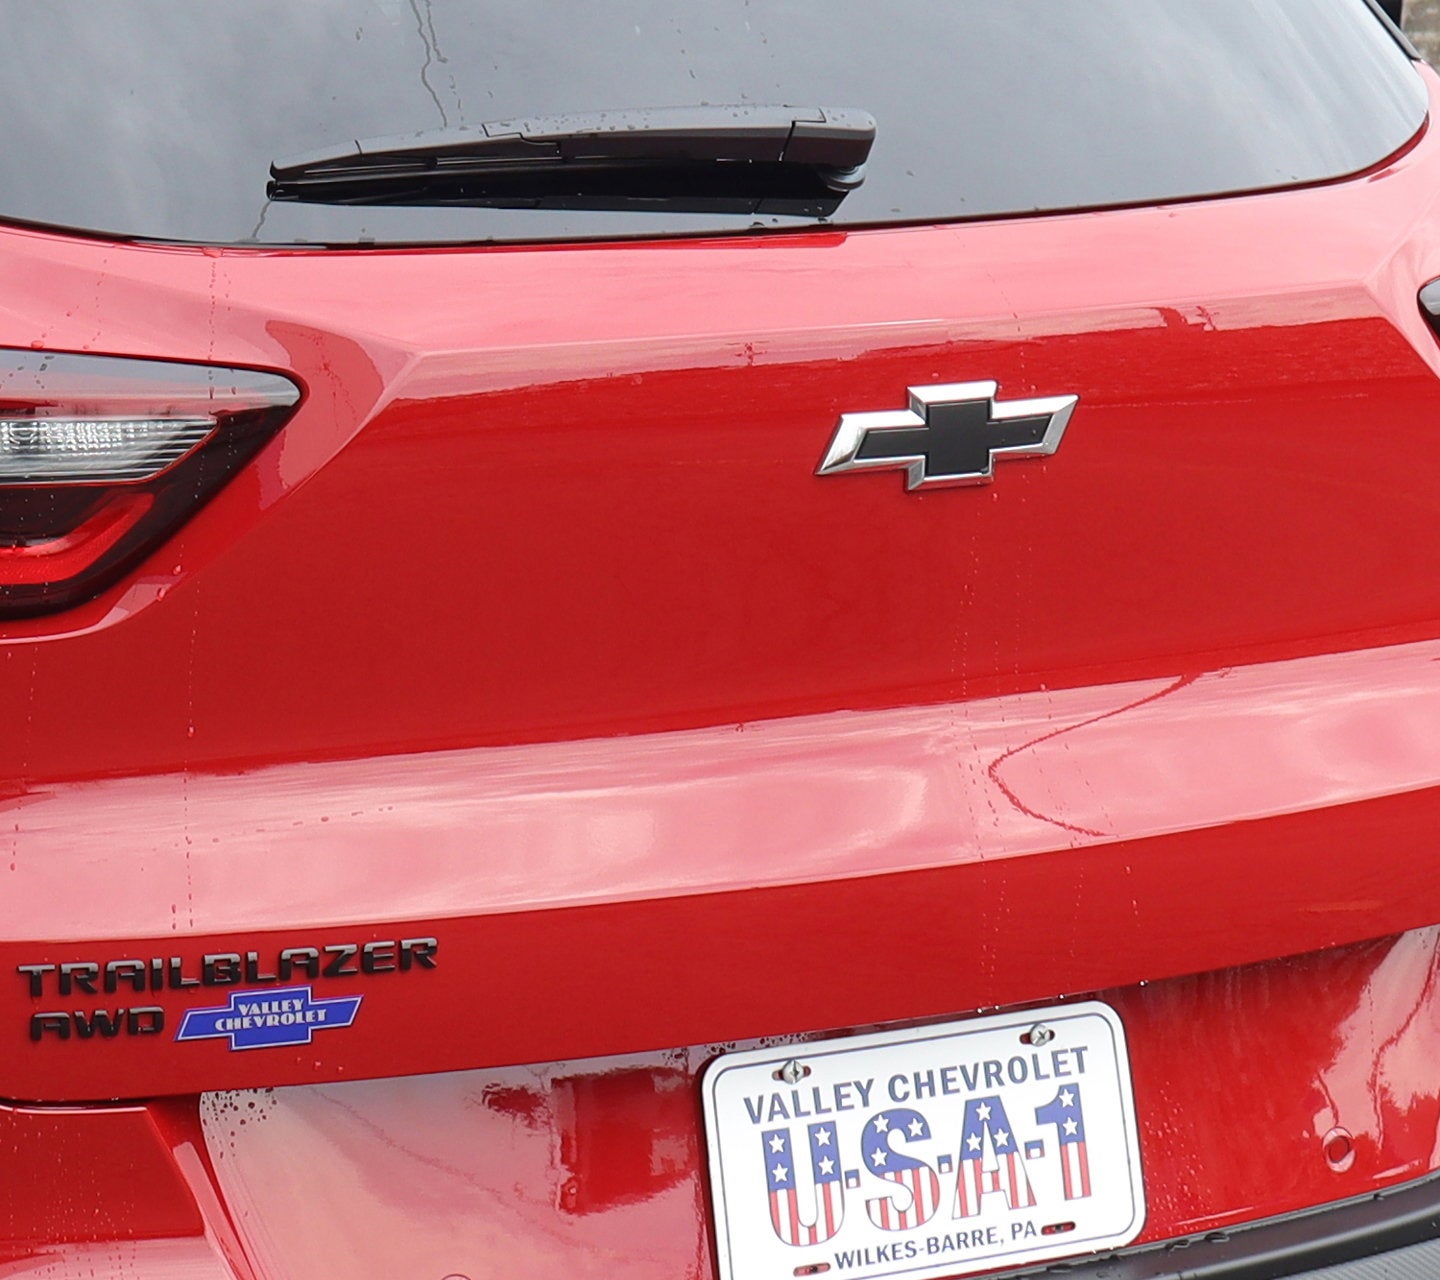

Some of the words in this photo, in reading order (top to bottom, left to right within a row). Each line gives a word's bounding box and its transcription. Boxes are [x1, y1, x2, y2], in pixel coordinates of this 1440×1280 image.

[17, 937, 439, 998] TRAILBLAZER
[31, 1006, 165, 1041] AWD
[215, 1009, 327, 1032] CHEVROLET
[238, 998, 304, 1017] VALLEY
[743, 1077, 875, 1125] VALLEY
[887, 1045, 1089, 1103] CHEVROLET
[834, 1226, 1005, 1270] WILKES-BARRE,
[1011, 1220, 1037, 1241] PA
